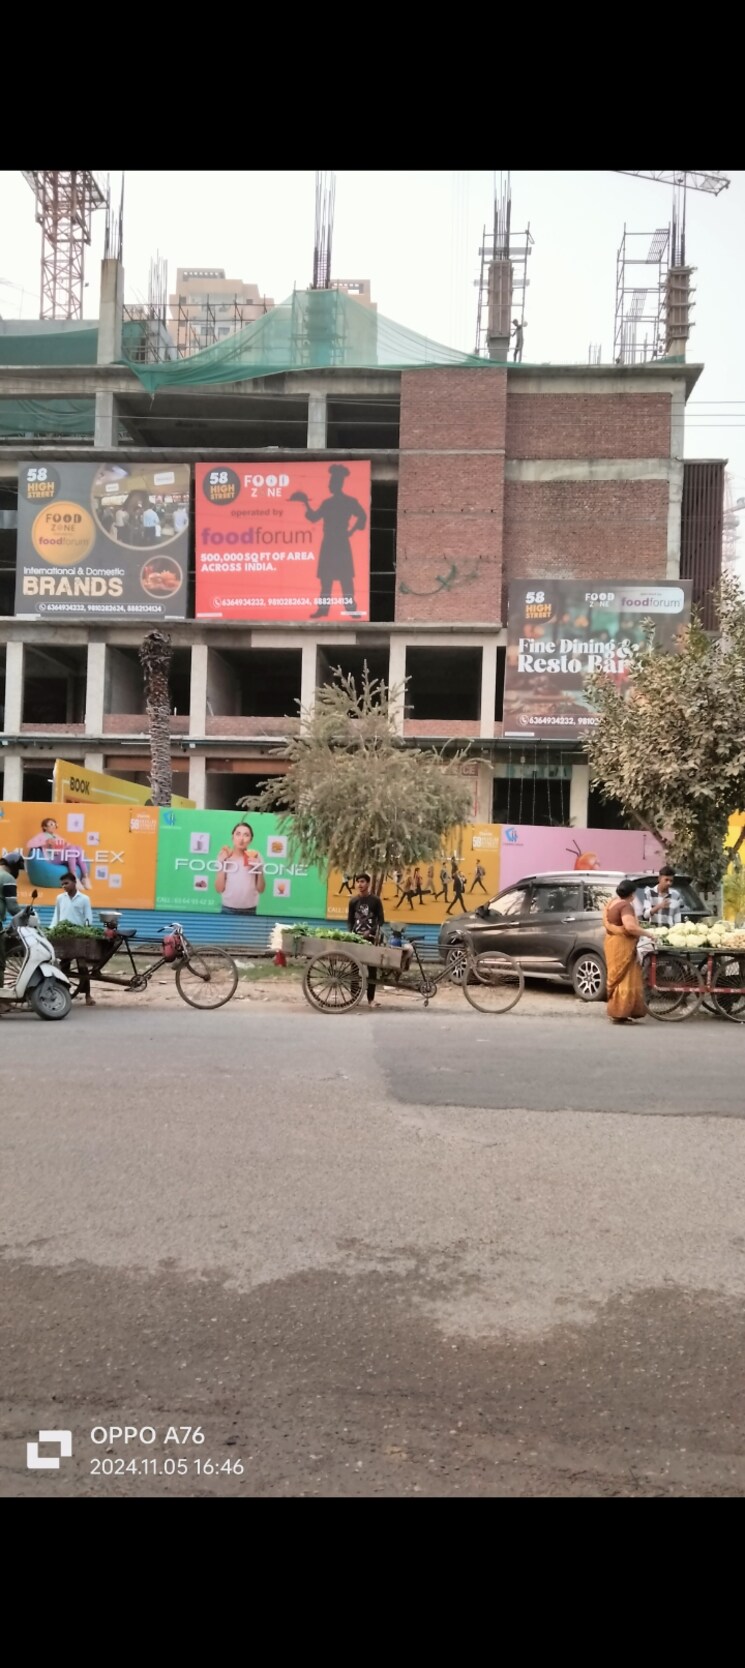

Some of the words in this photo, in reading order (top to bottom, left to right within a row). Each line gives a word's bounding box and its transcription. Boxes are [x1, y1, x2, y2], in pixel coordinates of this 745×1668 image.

[27, 467, 48, 482] 58
[209, 471, 229, 485] 58
[243, 473, 290, 488] FOOD
[27, 482, 55, 492] HIGH
[210, 484, 235, 494] HIGH
[27, 491, 54, 499] STREET
[210, 492, 235, 500] STREET
[45, 513, 82, 524] FOOD
[231, 508, 271, 518] operated
[272, 508, 284, 518] by
[39, 536, 89, 546] foodforum
[201, 527, 313, 546] foodforum
[200, 553, 244, 563] 500,000
[244, 553, 259, 563] SQ
[259, 552, 271, 562] FT
[271, 552, 286, 561] OF
[287, 551, 315, 562] AREA
[23, 566, 76, 576] International
[76, 567, 85, 576] &
[85, 567, 125, 577] Domestic
[201, 562, 242, 573] ACROSS
[244, 562, 277, 572] INDIA.
[22, 576, 123, 597] BRANDS
[525, 591, 545, 604] 58
[584, 592, 616, 601] FOOD
[621, 597, 681, 608] foodforum
[525, 604, 552, 613] HIGH
[518, 638, 556, 654] Fine
[559, 638, 616, 659] Dining
[617, 638, 640, 659] &
[517, 654, 582, 674] Resto
[587, 654, 627, 674] Bar
[69, 776, 91, 796] BOOK
[1, 848, 125, 863] MULTIPLEX
[174, 858, 239, 873] FOOD
[247, 863, 308, 877] ZONE
